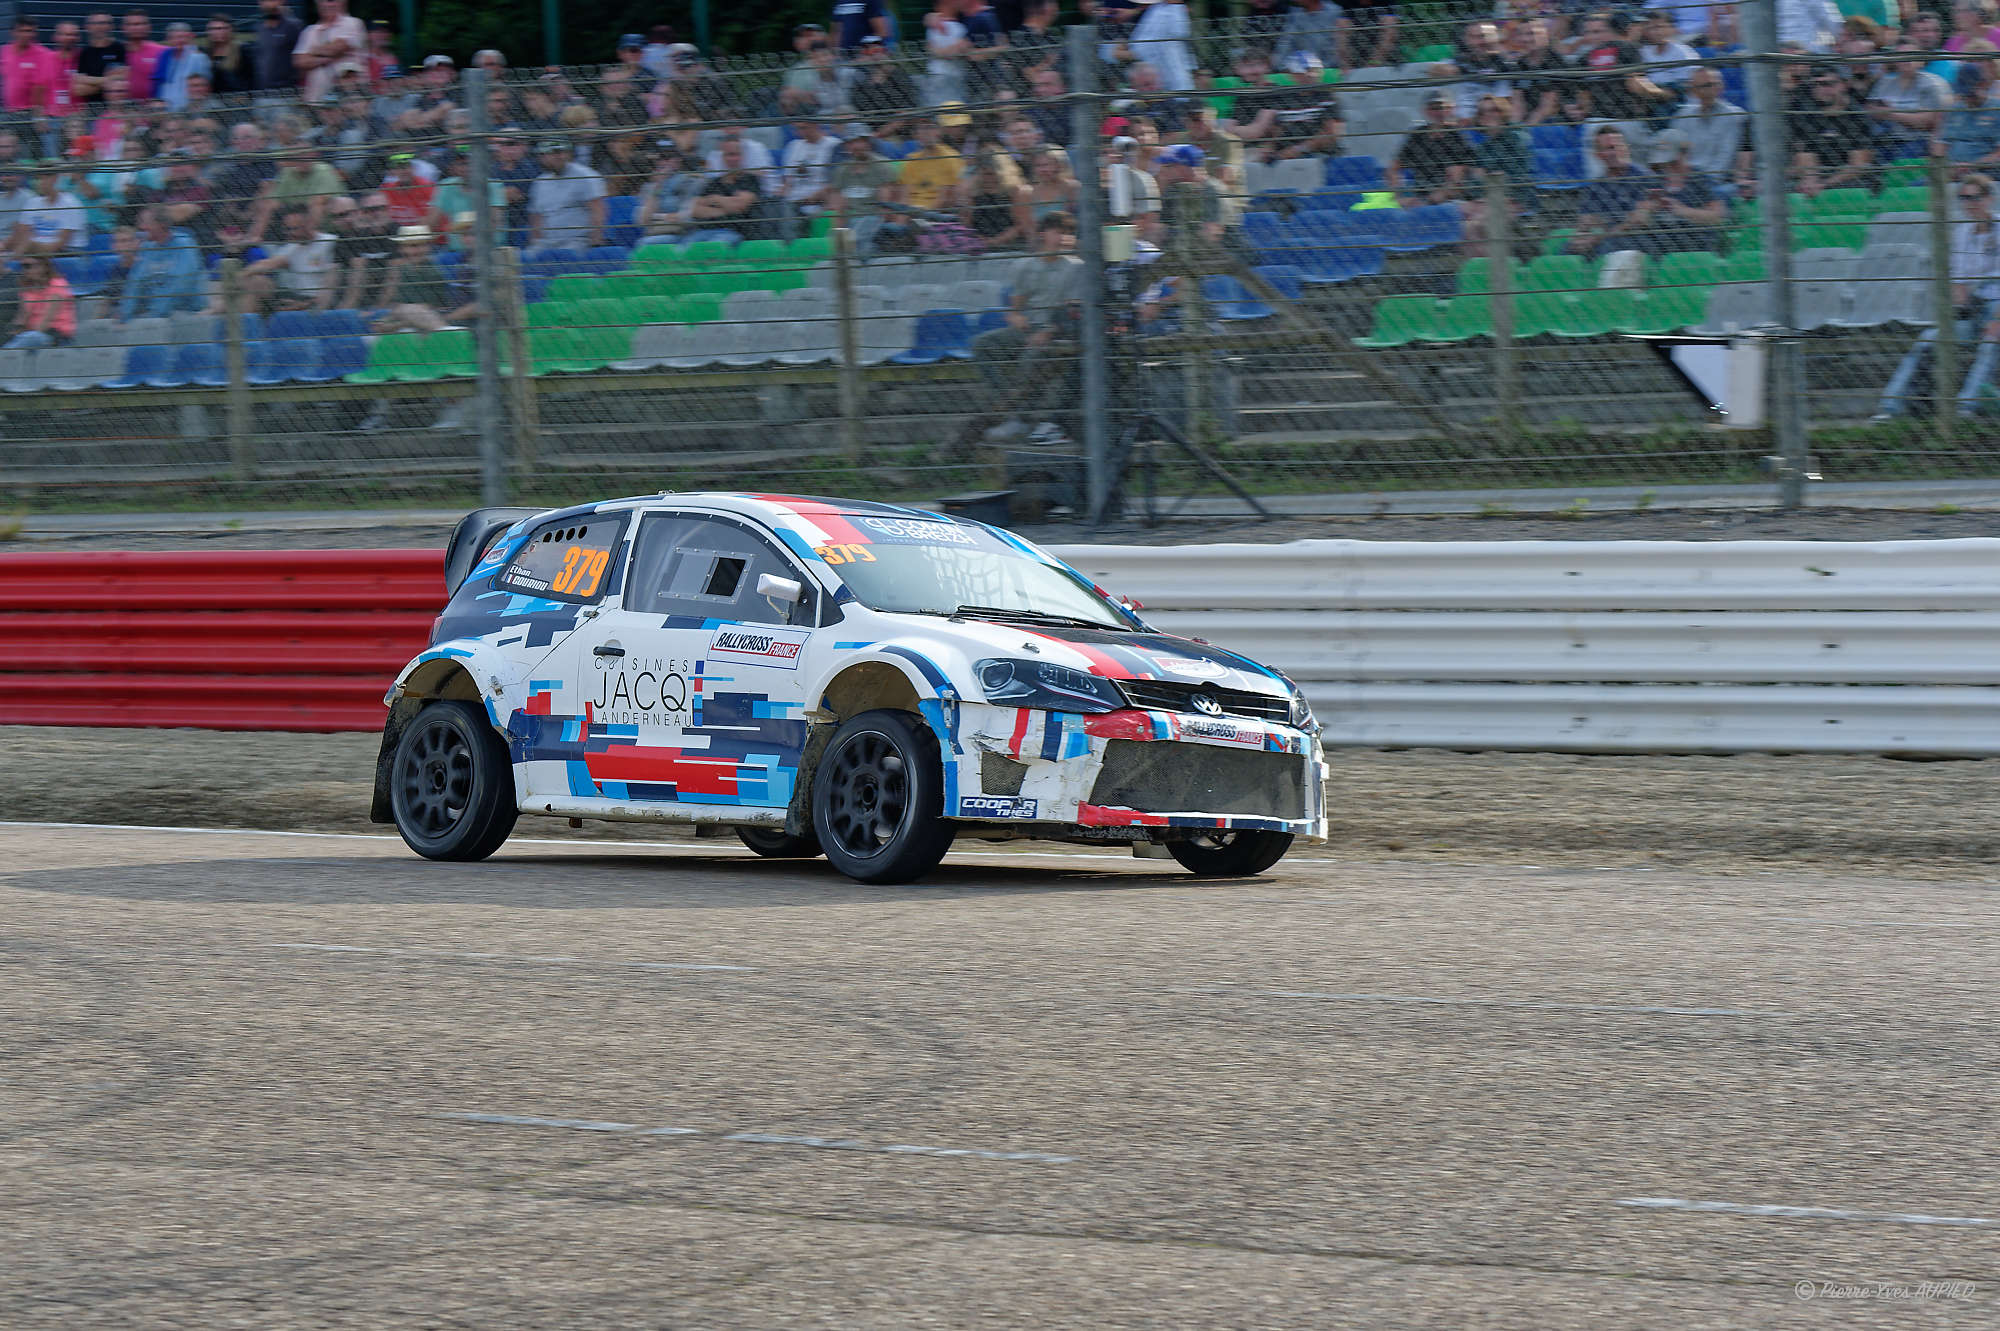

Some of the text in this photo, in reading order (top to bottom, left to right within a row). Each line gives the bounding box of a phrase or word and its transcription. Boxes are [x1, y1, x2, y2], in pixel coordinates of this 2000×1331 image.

[814, 543, 877, 565] 379
[509, 565, 532, 577] Ethan
[552, 546, 610, 597] 379
[716, 632, 800, 658] RALLYCROSS FRANCE
[594, 656, 689, 673] CUISINES
[593, 671, 687, 712] JACQ
[593, 711, 692, 728] LANDERNEAU
[961, 798, 1036, 810] COOPR
